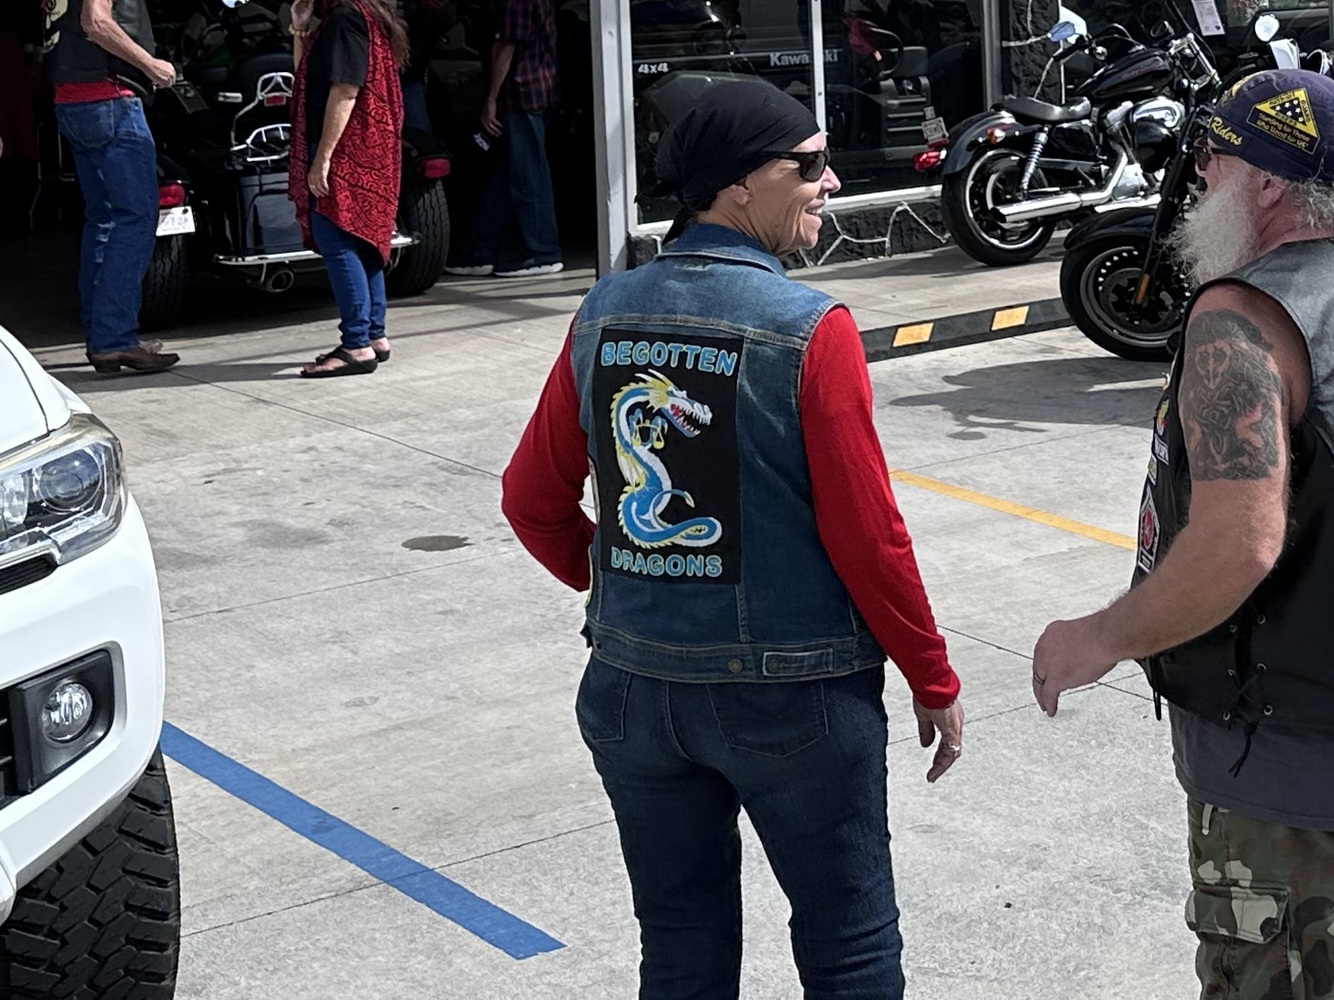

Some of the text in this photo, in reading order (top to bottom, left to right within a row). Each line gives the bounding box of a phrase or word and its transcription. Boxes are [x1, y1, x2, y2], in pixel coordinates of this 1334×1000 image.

[638, 63, 669, 73] 4x4
[770, 50, 838, 66] Kawaki
[1211, 116, 1242, 145] Riders
[601, 341, 738, 377] BEGOTTEN
[611, 546, 722, 578] DRAGONS
